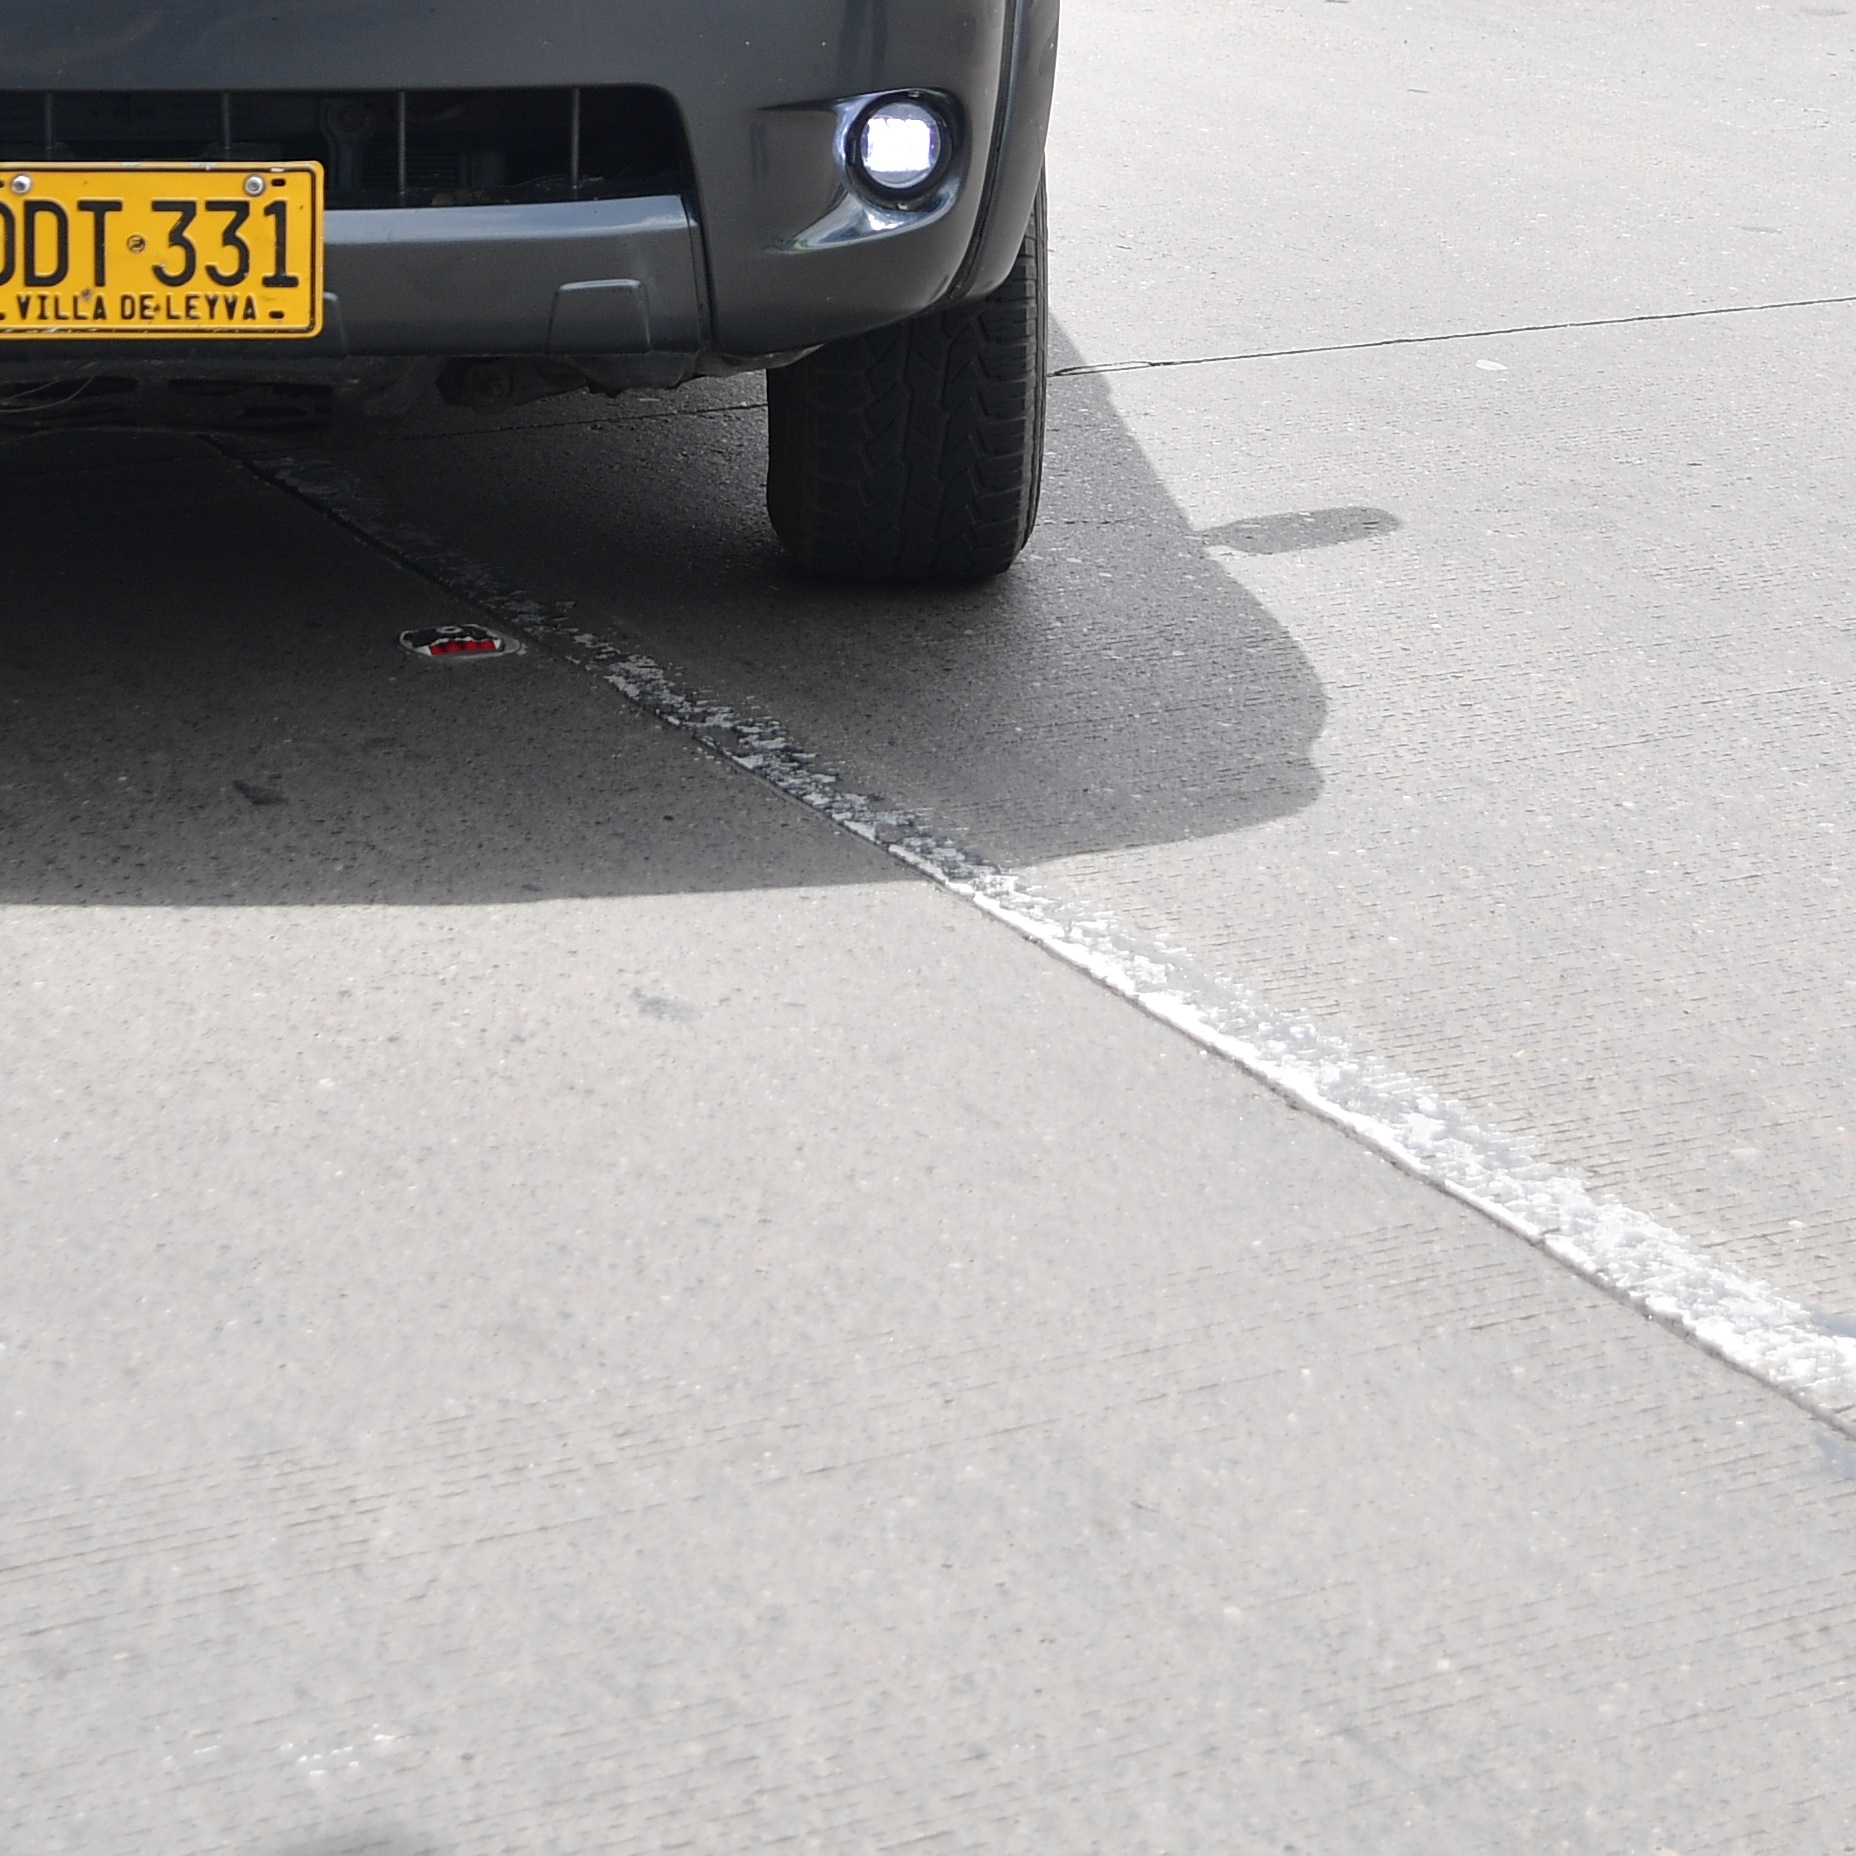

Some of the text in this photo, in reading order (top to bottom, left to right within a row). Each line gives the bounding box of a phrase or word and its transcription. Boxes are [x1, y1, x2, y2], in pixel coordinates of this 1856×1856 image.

[151, 200, 300, 288] 331
[16, 294, 257, 321] VILLA DE LEYVA
